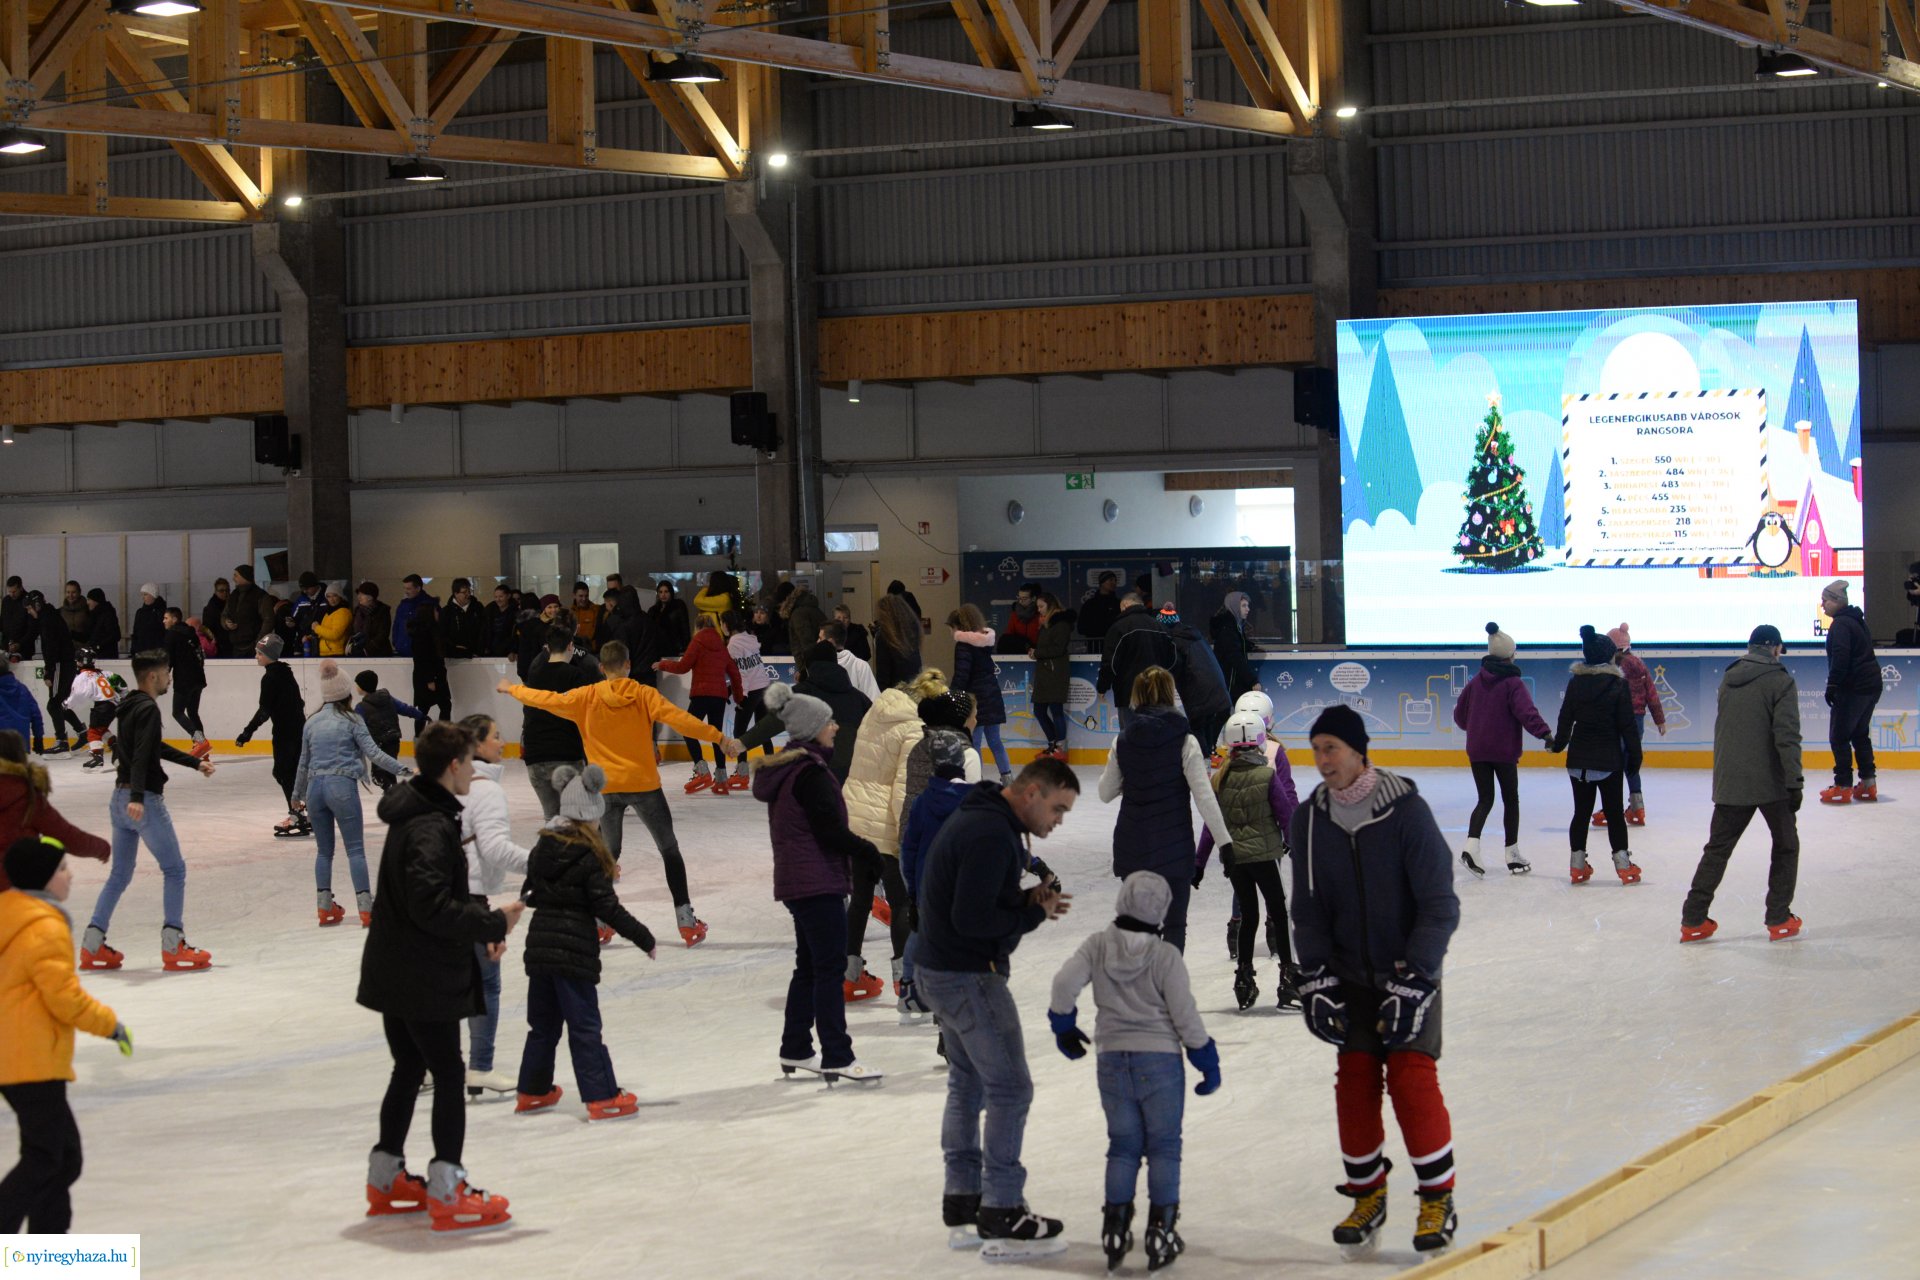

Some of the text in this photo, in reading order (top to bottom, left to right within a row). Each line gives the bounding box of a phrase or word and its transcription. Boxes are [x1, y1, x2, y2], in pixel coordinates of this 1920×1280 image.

[1590, 411, 1741, 424] LEGENERGIKUSABB VÁROSOK
[1637, 426, 1694, 435] RANGSORA
[1654, 456, 1672, 464] 550
[1598, 470, 1606, 478] 2.
[1666, 468, 1684, 476] 484
[1604, 482, 1612, 490] 3.
[1616, 494, 1626, 502] 4.
[1601, 507, 1609, 515] 5.
[1598, 519, 1606, 527] 6.
[1601, 531, 1609, 539] 7.
[1674, 530, 1688, 538] 115
[96, 675, 115, 699] 8
